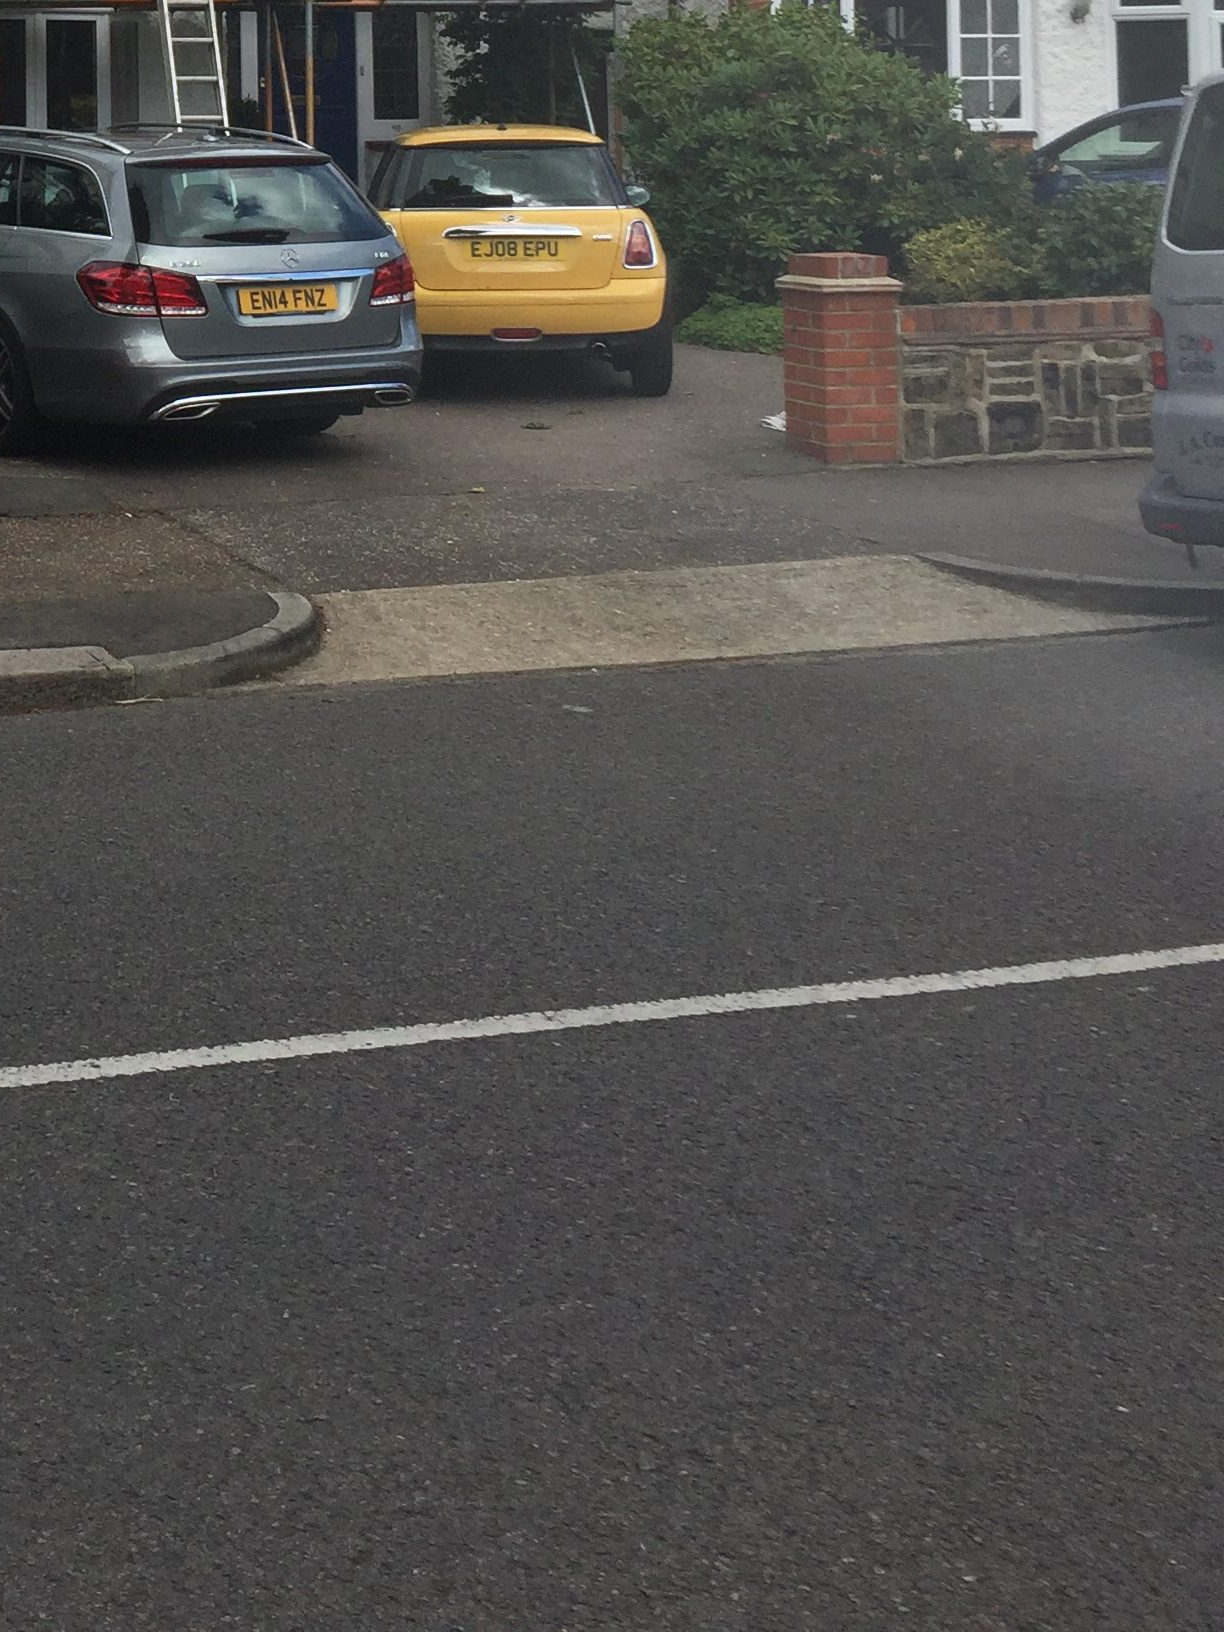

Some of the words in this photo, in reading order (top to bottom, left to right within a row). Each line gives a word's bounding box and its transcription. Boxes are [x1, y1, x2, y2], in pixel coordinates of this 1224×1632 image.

[470, 241, 518, 258] EJ08
[523, 240, 559, 257] EPU
[249, 290, 288, 311] EN14
[293, 288, 328, 309] FNZ
